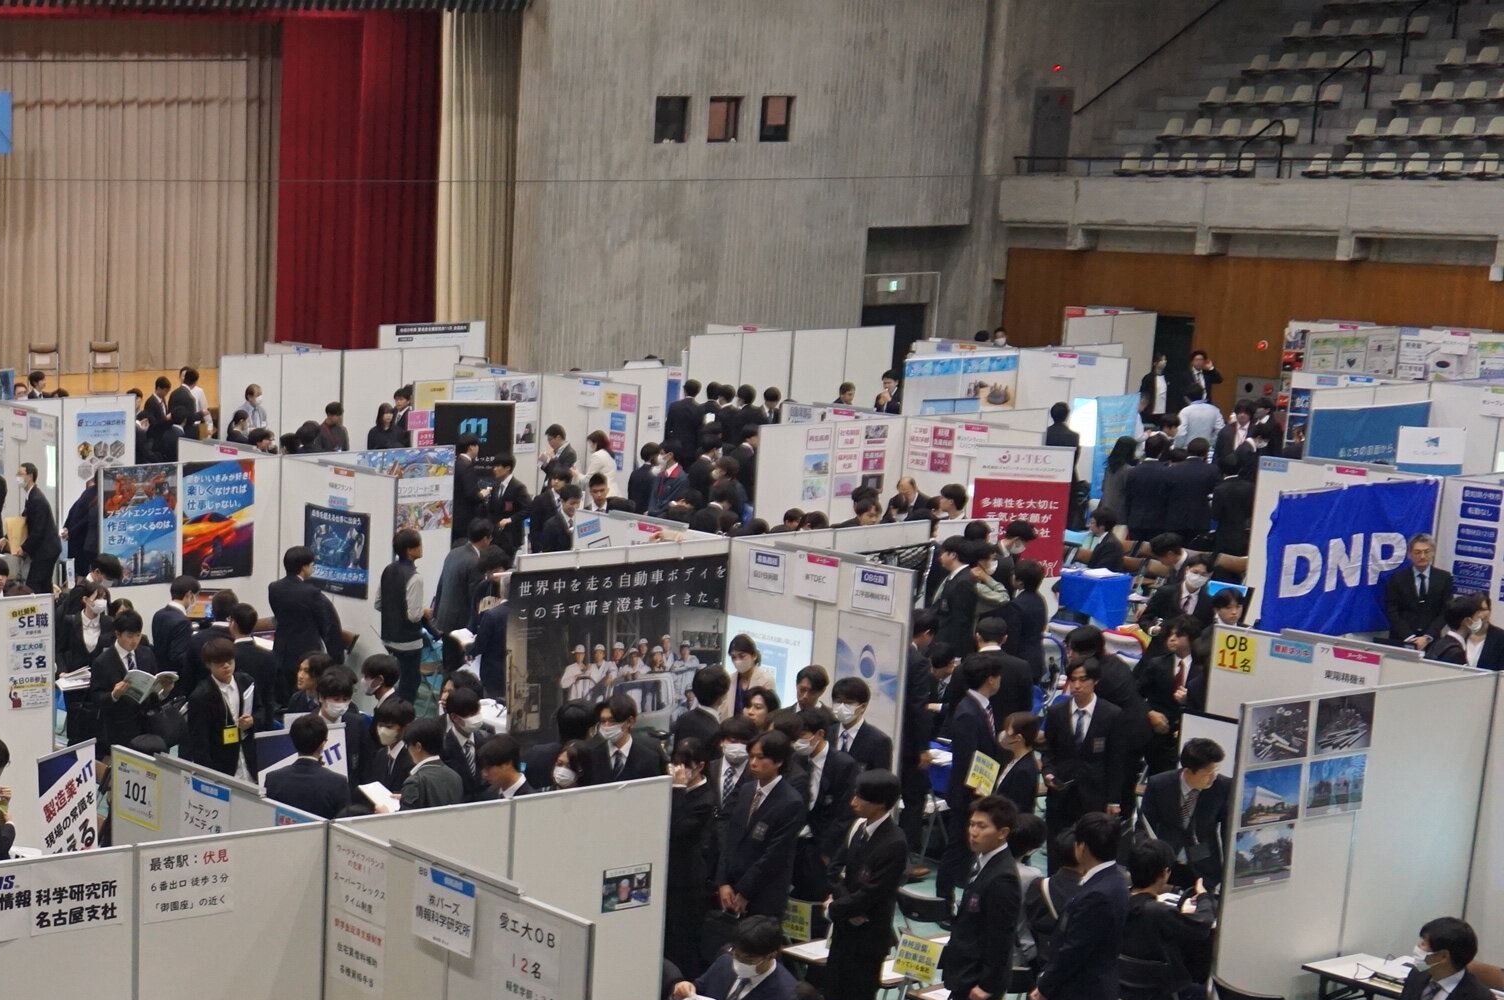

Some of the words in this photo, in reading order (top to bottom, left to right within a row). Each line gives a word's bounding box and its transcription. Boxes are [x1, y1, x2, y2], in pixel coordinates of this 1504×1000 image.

[1279, 532, 1407, 598] DNP
[517, 591, 720, 621] この手で研ぎ澄ましてきた。
[18, 613, 49, 629] SE職
[1225, 634, 1248, 652] OB
[1345, 651, 1368, 661] メーカー
[22, 655, 47, 669] 5名
[1217, 650, 1251, 673] 11名
[43, 760, 93, 824] 製造業×IT
[187, 800, 219, 820] トーテック
[35, 879, 117, 908] 科学研究所
[150, 879, 187, 893] 6番出口
[190, 873, 230, 888] 徒歩3分
[333, 872, 386, 900] スーパーフレックス
[35, 902, 117, 929] 名古屋支社
[415, 904, 472, 939] 情報科学研究所
[499, 912, 556, 949] 愛工大OB
[512, 953, 542, 980] 12名
